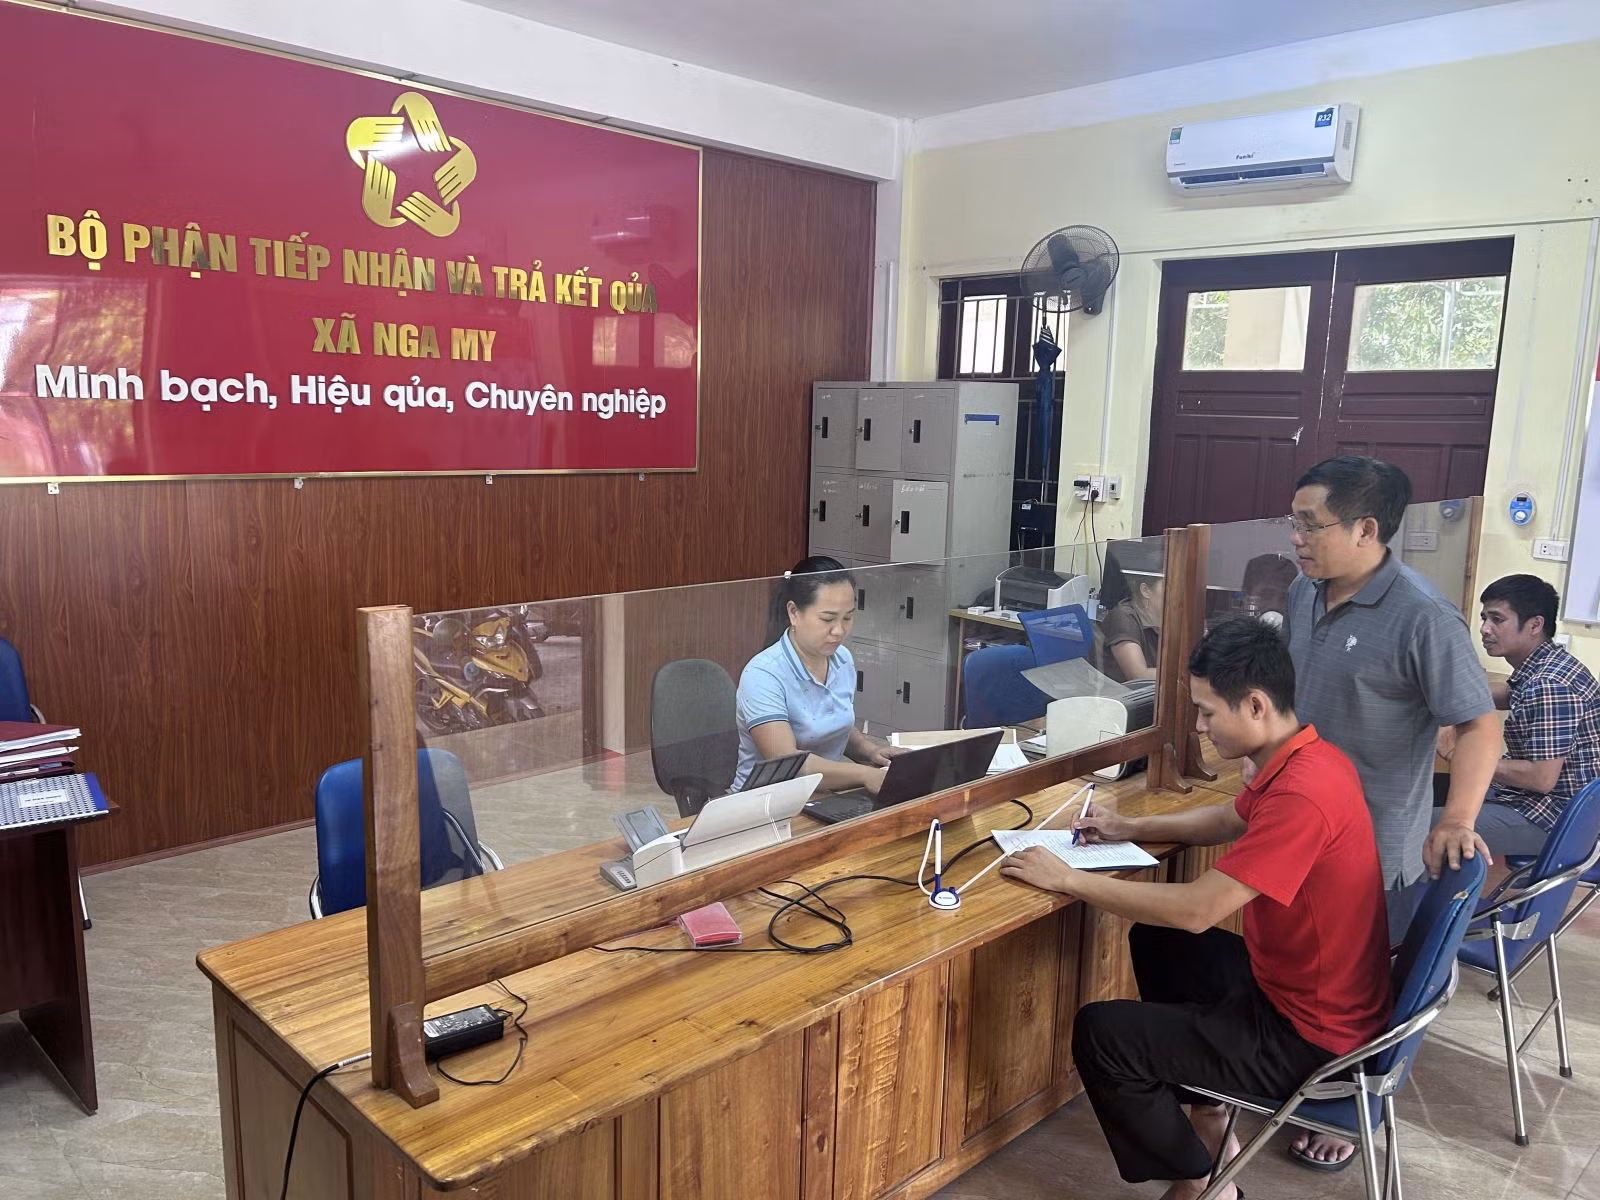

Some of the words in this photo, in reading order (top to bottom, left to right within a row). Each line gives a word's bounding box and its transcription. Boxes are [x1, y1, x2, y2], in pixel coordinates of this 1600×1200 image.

[1316, 113, 1332, 122] R32
[47, 209, 107, 270] BỘ
[122, 222, 238, 279] PHẬN
[250, 231, 331, 281] TIẾP
[342, 248, 436, 297] NHẬN
[446, 255, 484, 297] VÀ
[492, 259, 547, 303] TRẢ
[554, 266, 603, 308] KẾT
[609, 271, 657, 315] QỦA
[312, 313, 361, 355] XÃ
[372, 321, 441, 359] NGA
[450, 327, 497, 362] MY
[35, 364, 144, 400] Minh
[159, 369, 277, 412] bạch,
[290, 375, 371, 413] Hiệu
[383, 375, 454, 413] qủa,
[465, 381, 573, 415] Chuyên
[581, 387, 667, 419] nghiệp
